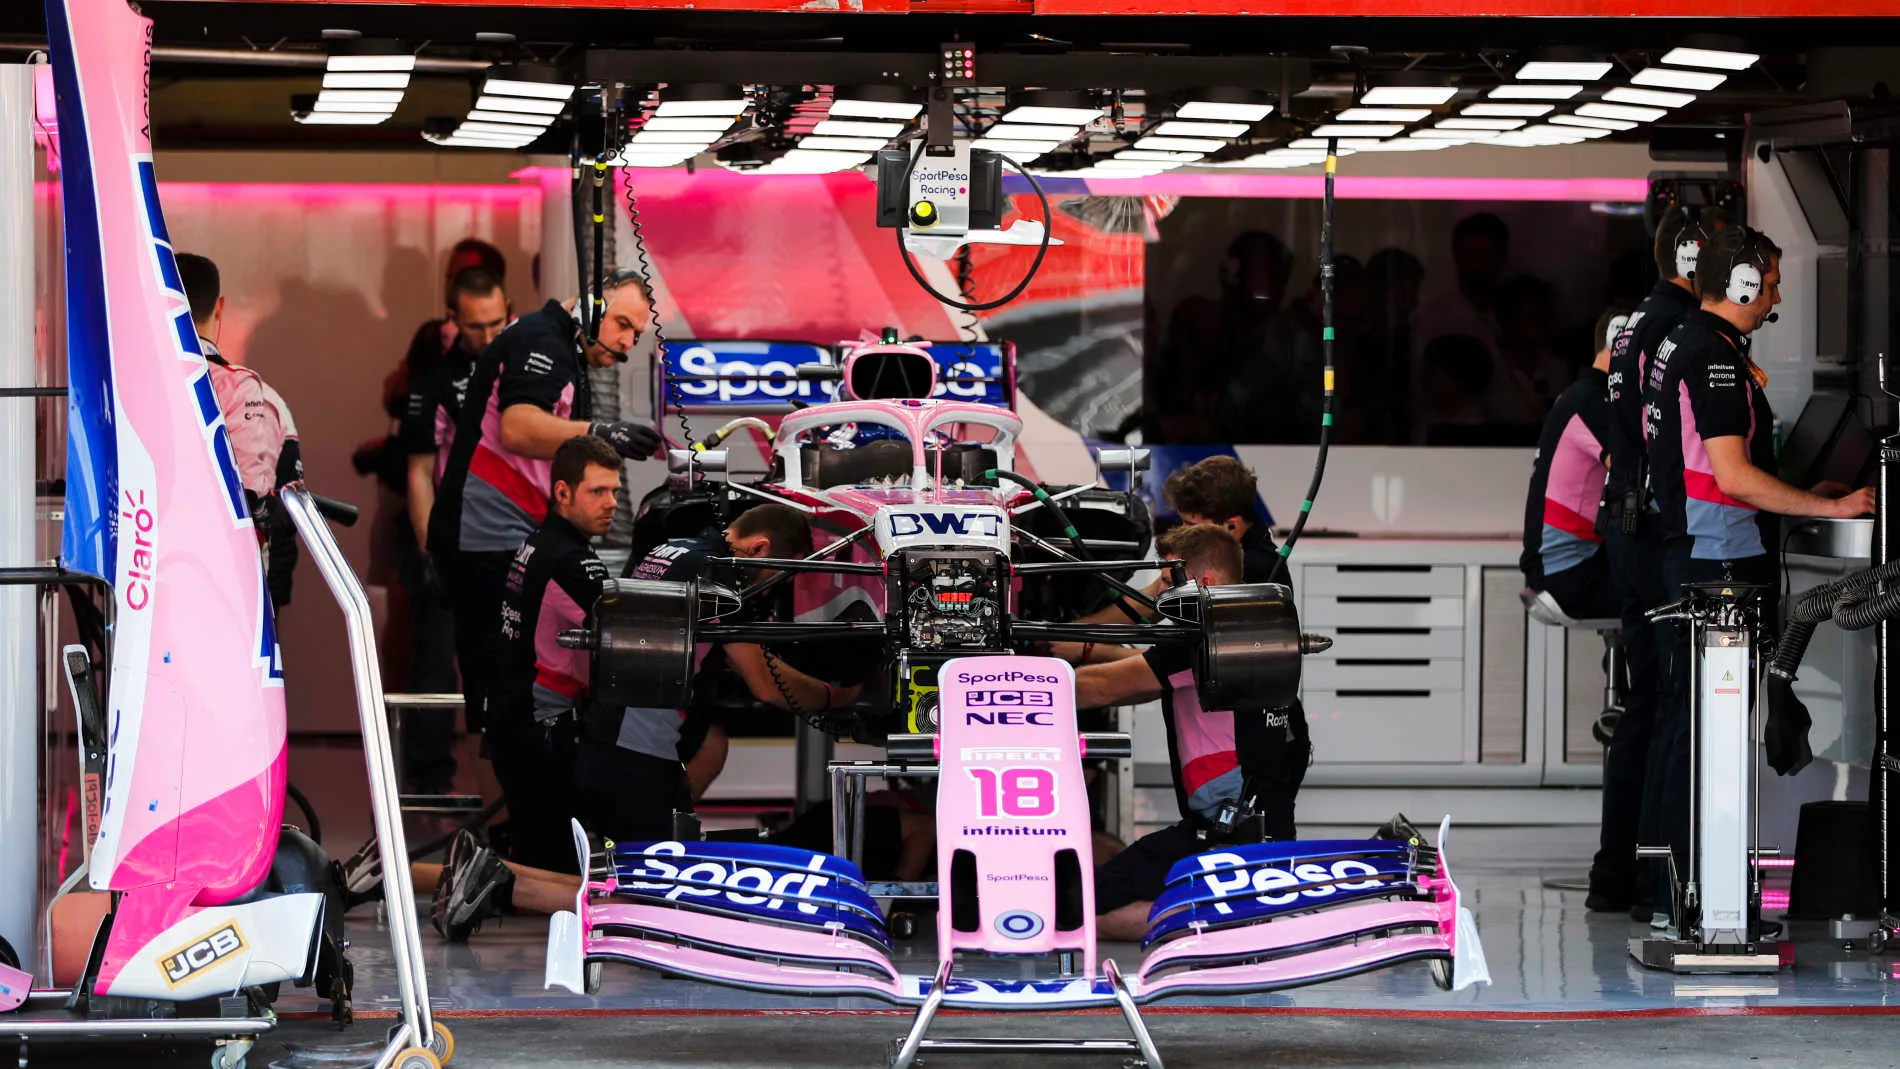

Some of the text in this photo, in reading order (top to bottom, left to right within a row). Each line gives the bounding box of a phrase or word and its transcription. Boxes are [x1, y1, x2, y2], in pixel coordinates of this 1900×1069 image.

[912, 170, 968, 182] SportPesa
[921, 185, 956, 197] Racing
[1708, 371, 1736, 380] Acronis
[889, 513, 1003, 537] BWT
[126, 508, 154, 611] Claro
[958, 671, 1059, 685] SportPesa
[967, 690, 1053, 707] JCB
[966, 712, 1055, 726] NEC
[963, 766, 1059, 820] 18
[963, 826, 1067, 836] infinitum
[633, 841, 1385, 915] Sport Pesa
[986, 873, 1049, 882] SportPesa
[167, 928, 240, 980] JCB
